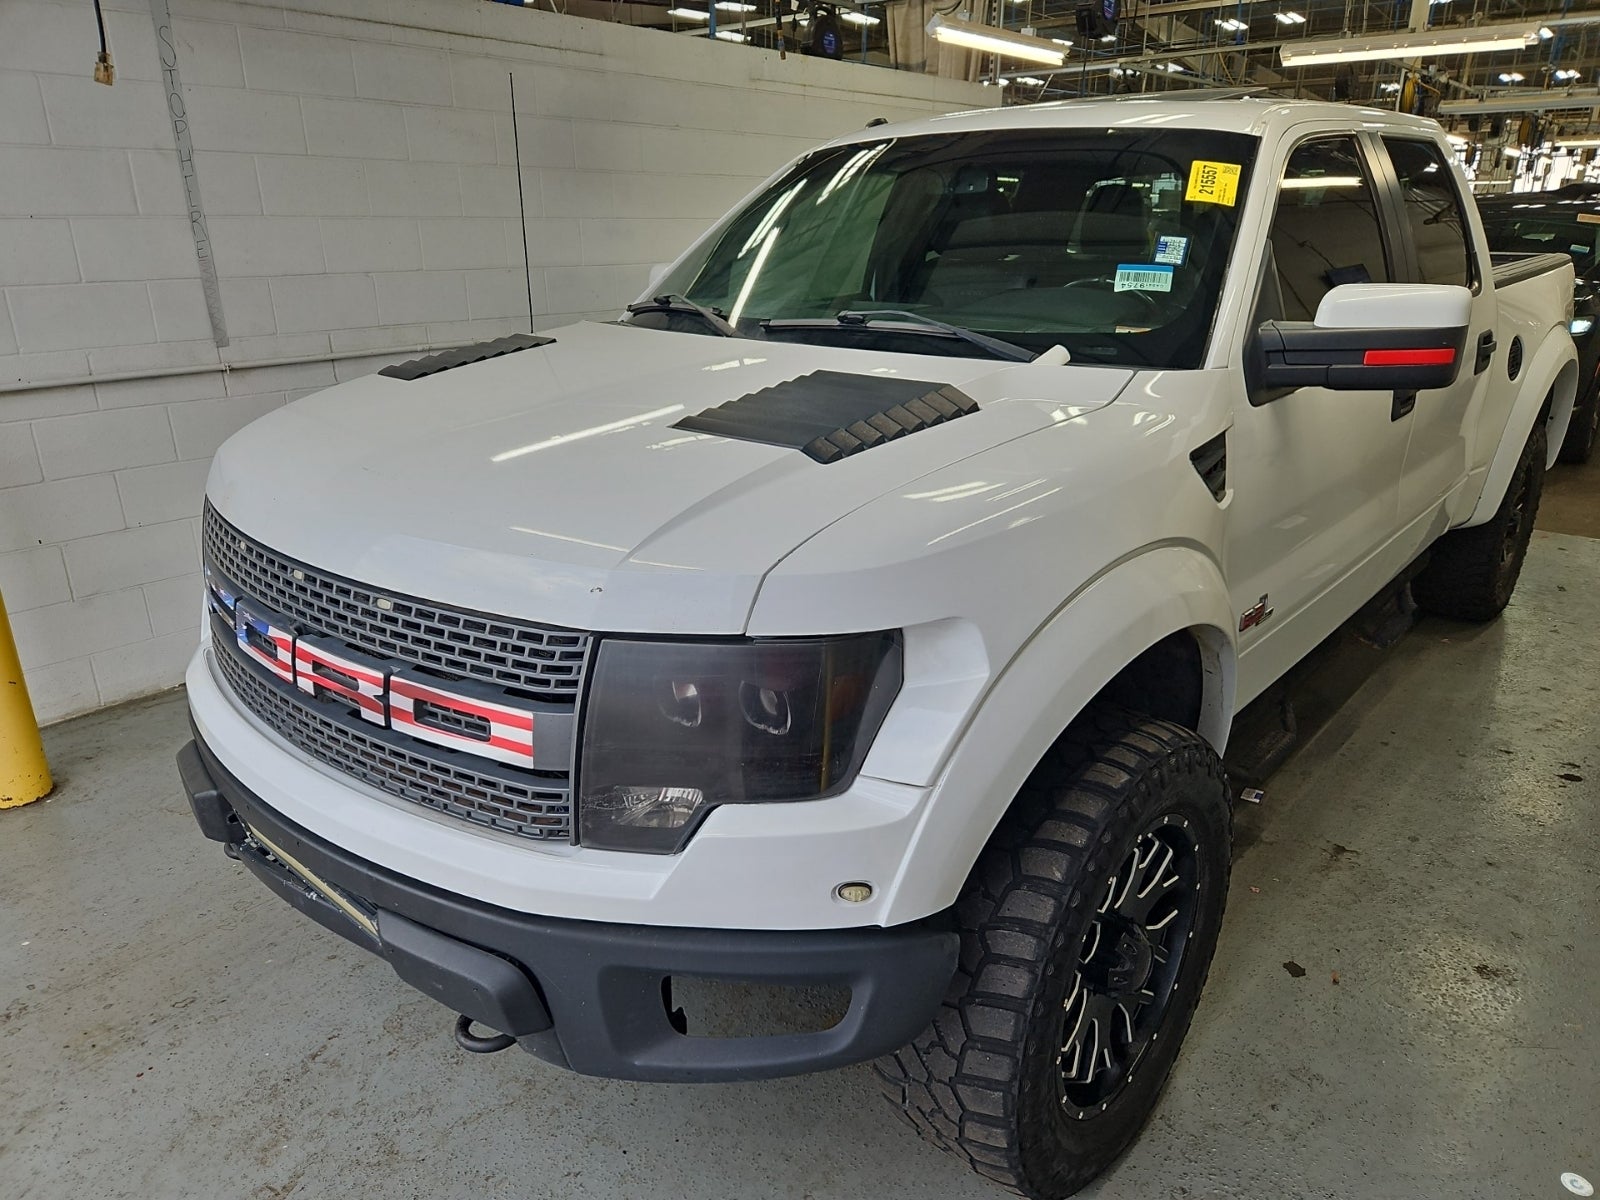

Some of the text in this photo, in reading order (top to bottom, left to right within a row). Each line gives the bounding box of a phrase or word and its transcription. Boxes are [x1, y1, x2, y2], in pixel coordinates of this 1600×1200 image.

[159, 25, 210, 262] STOP HERE
[1198, 164, 1219, 196] 215557
